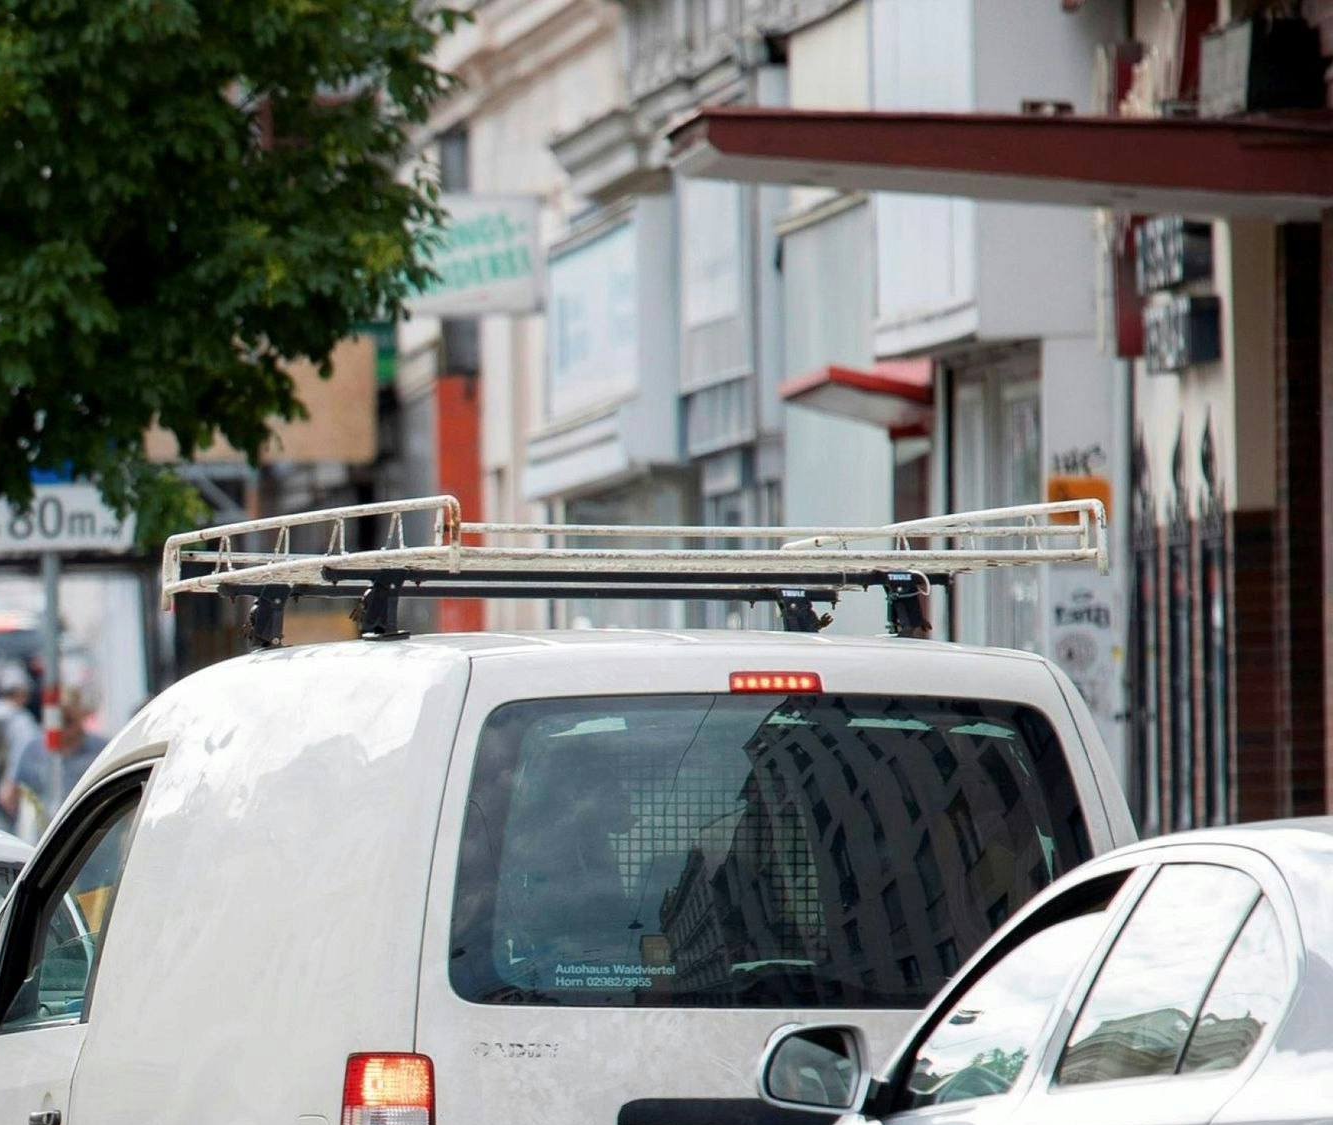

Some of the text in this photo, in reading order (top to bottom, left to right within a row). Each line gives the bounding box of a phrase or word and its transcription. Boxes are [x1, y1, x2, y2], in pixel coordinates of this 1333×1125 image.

[555, 963, 676, 975] Autohaus Waldviertel
[555, 976, 584, 987] Horn
